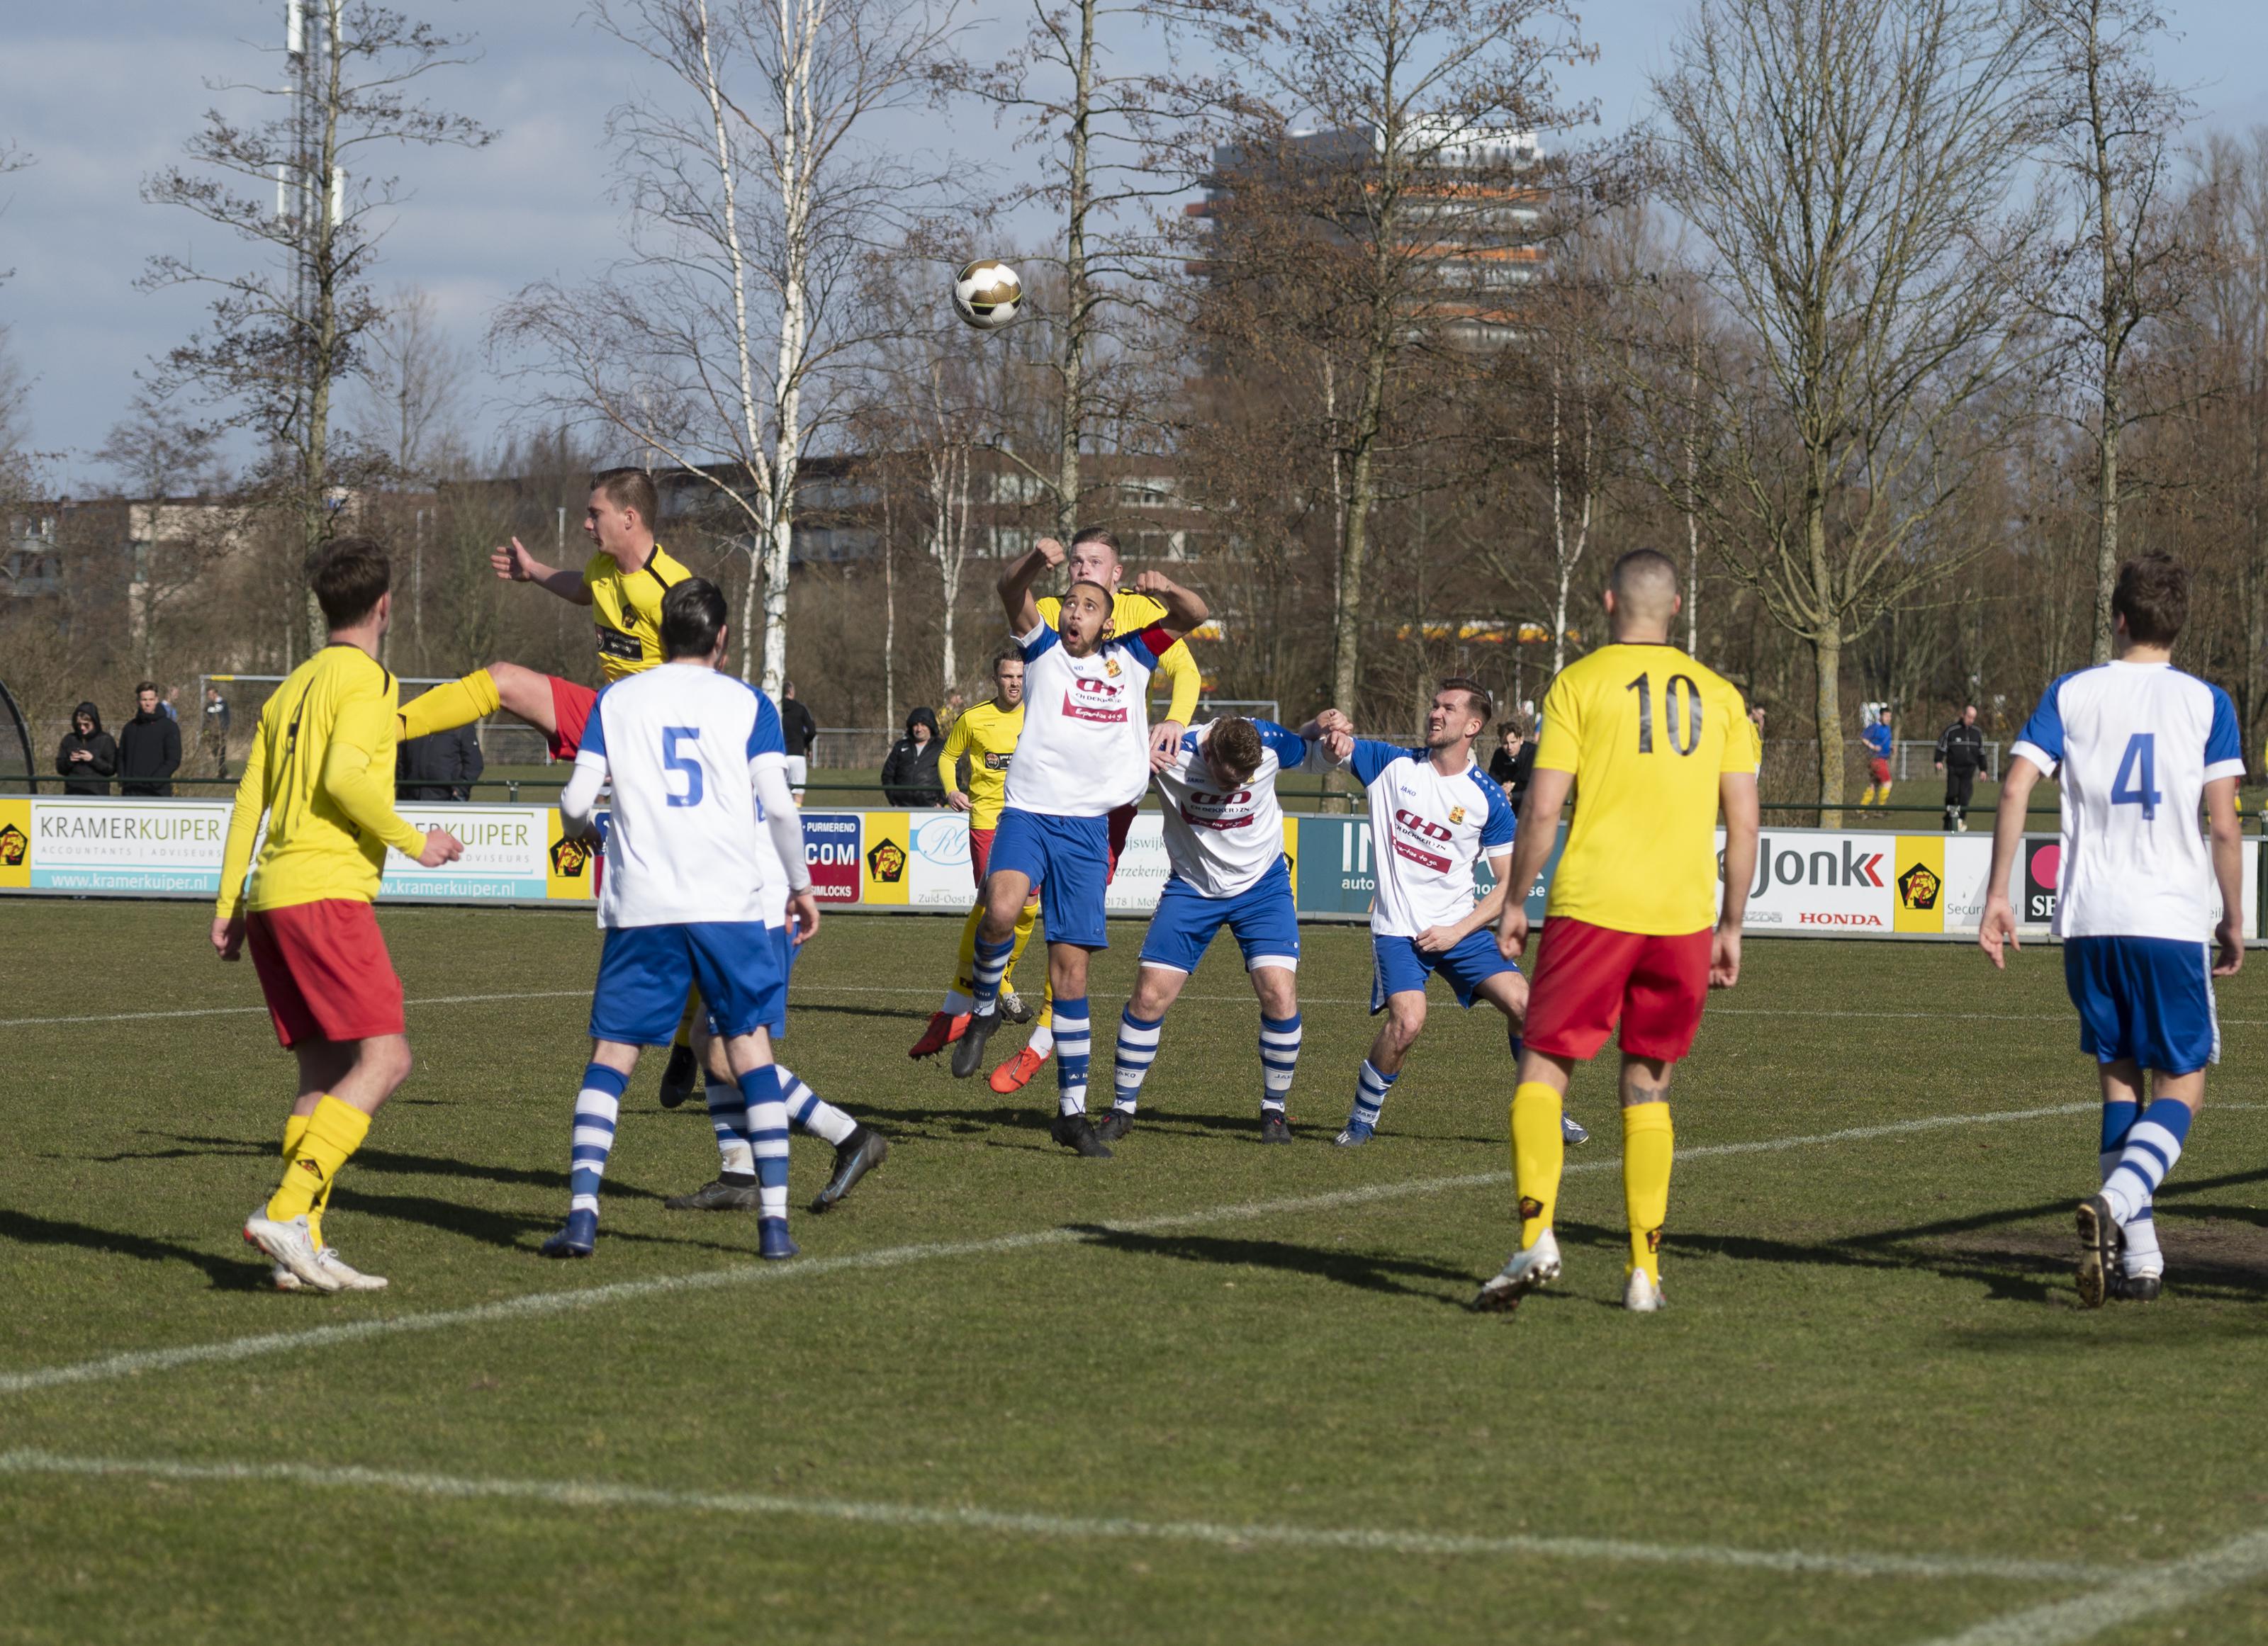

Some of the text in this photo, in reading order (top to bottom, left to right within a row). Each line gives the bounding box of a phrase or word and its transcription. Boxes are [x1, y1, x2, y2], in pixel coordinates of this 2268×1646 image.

[1625, 671, 1702, 756] 10
[662, 726, 703, 807] 5
[2111, 733, 2162, 821] 4
[1400, 786, 1416, 796] JAKO
[41, 816, 220, 840] KRAMERKUIPER
[807, 822, 856, 833] PURMEREND
[41, 846, 132, 856] ACCOUNTANTS
[465, 854, 529, 863] DVISEURS
[51, 873, 208, 891] www.kramerkuiper.nl
[381, 879, 515, 897] w.kramerkuiper.nl
[919, 894, 965, 903] Zuid-Oost
[1800, 913, 1883, 925] HONDA
